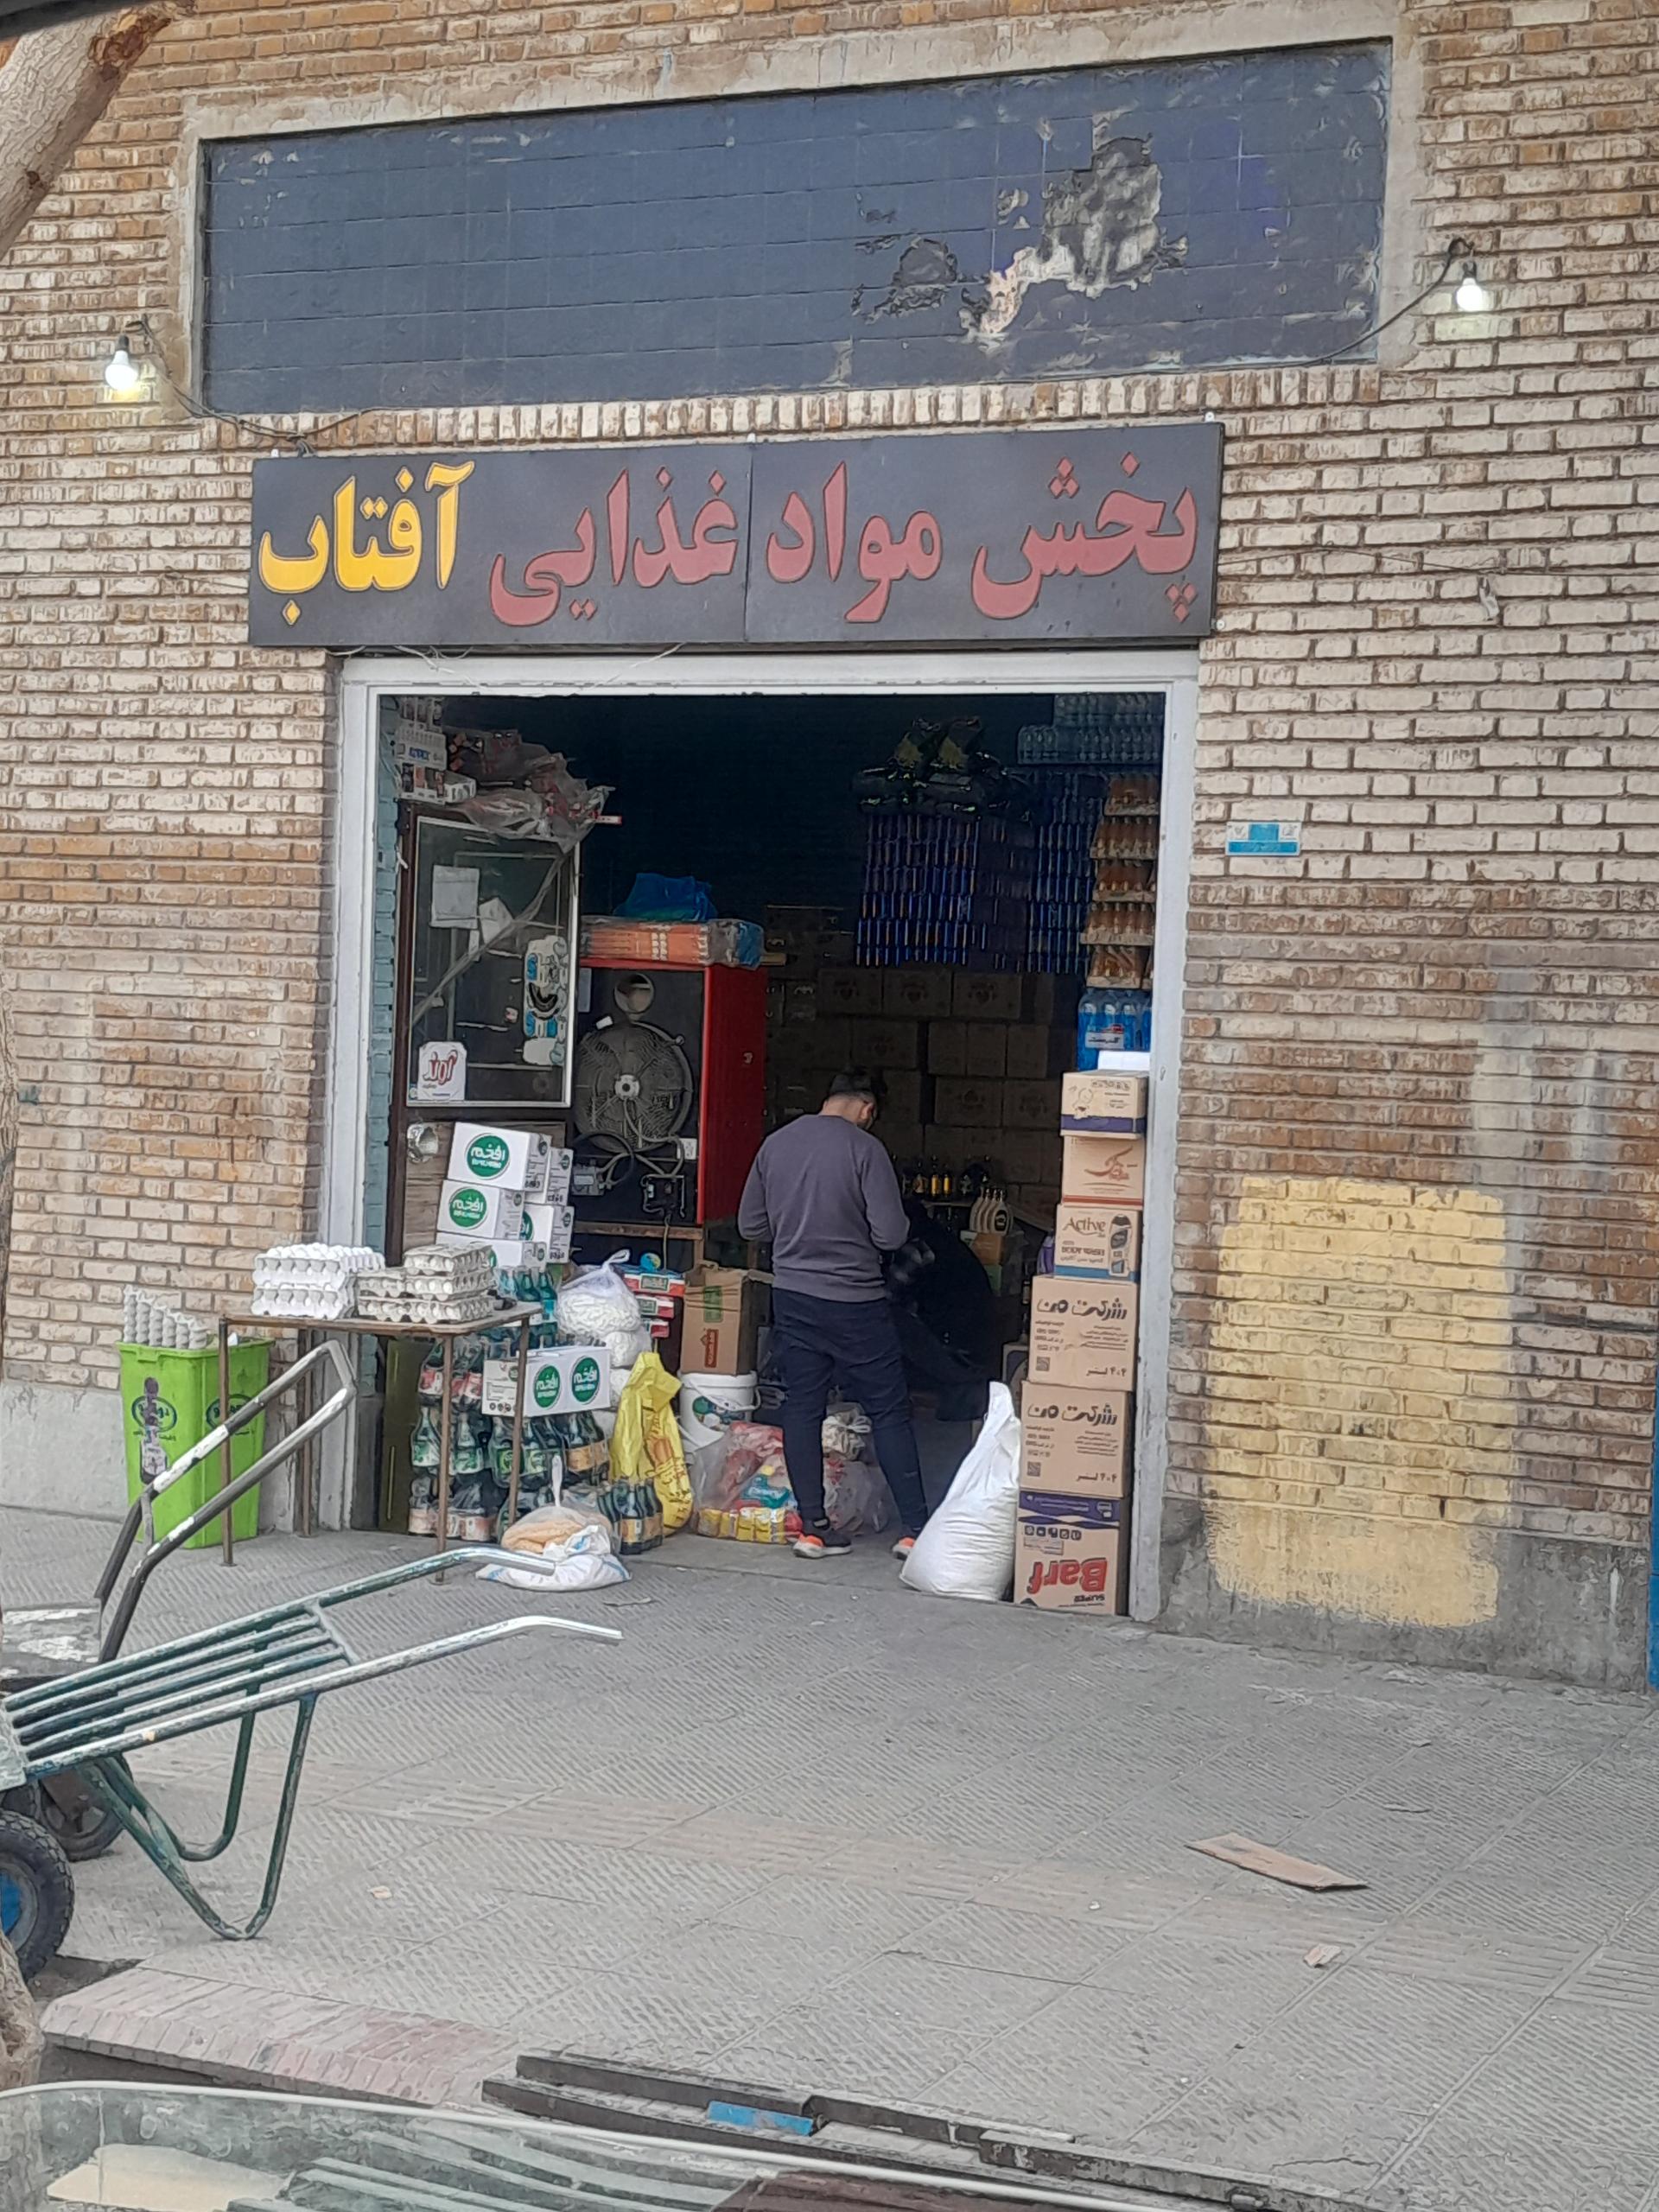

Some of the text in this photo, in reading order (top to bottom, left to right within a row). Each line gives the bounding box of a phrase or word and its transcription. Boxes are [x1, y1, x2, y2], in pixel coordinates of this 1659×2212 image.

[258, 451, 1198, 626] پخش مواد غذایی آفتاب
[1062, 1216, 1106, 1234] Active
[1027, 1557, 1108, 1595] Barf
